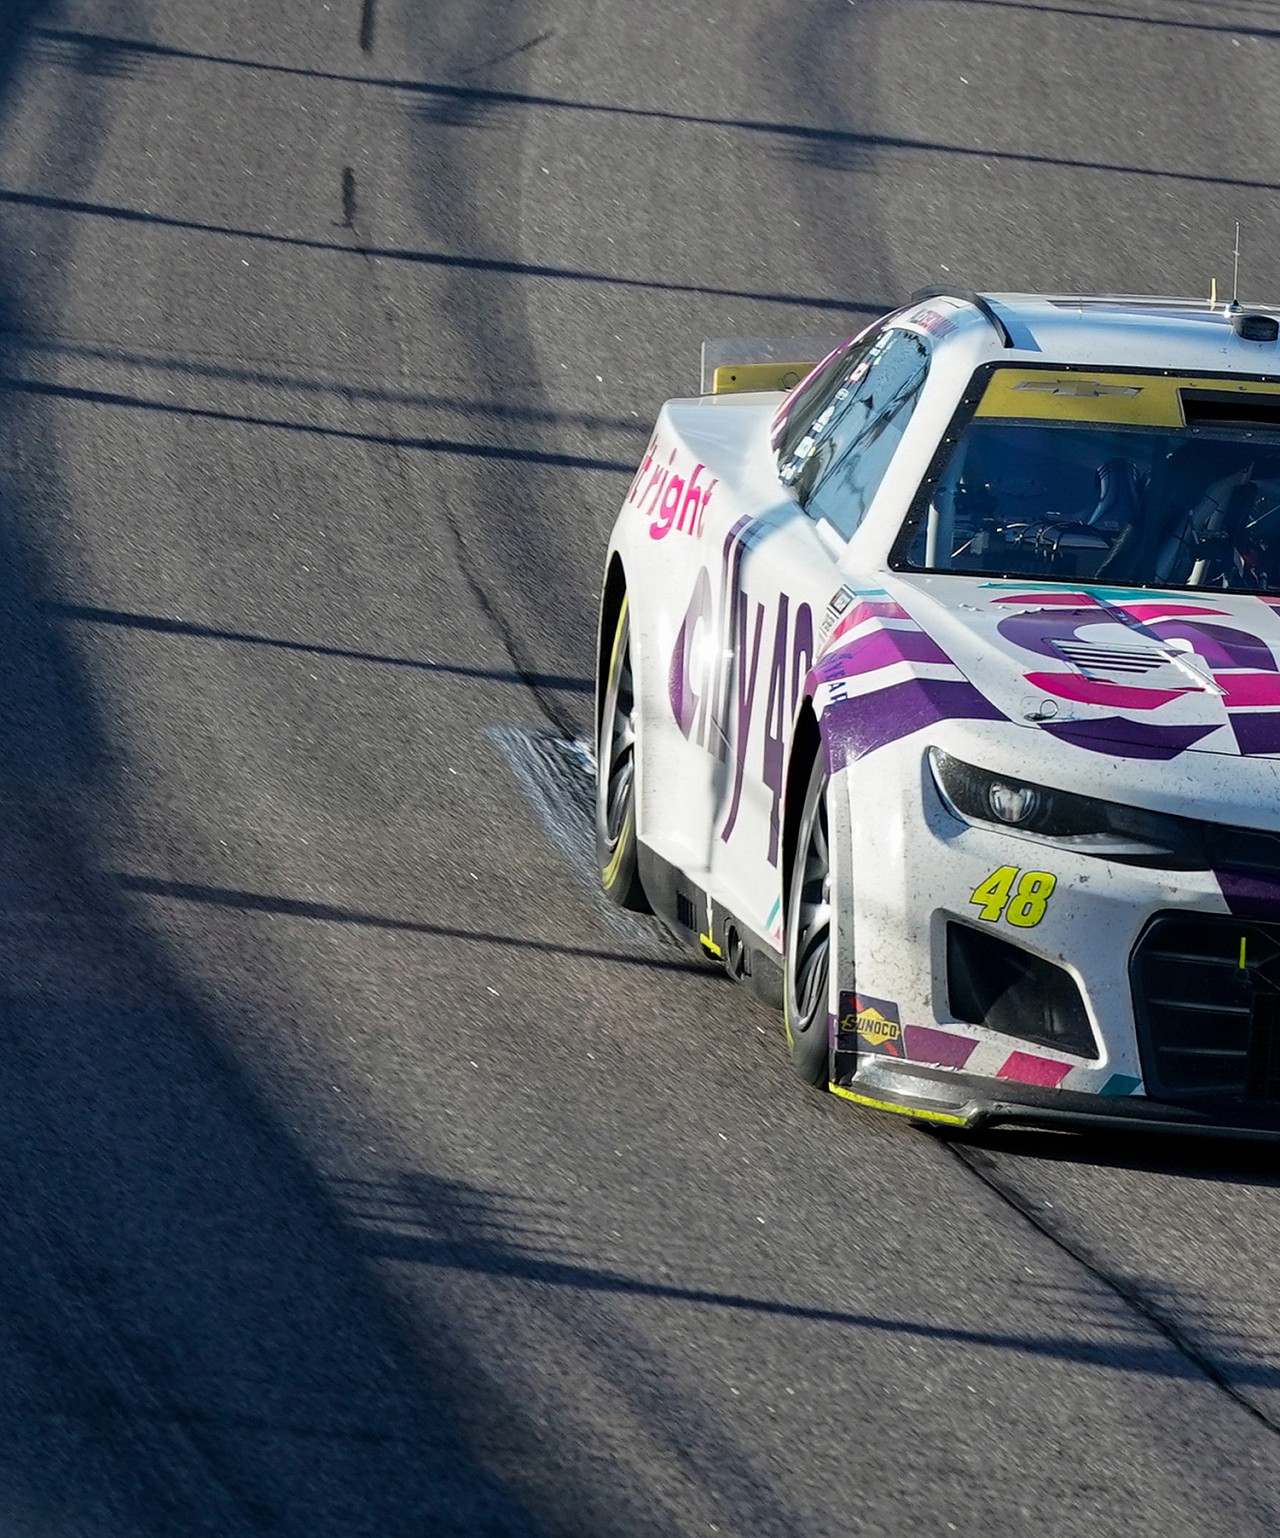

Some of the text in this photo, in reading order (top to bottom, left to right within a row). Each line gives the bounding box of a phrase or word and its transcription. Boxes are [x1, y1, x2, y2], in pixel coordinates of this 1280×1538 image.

[637, 447, 719, 541] right
[969, 865, 1058, 928] 48
[842, 1015, 898, 1039] SUNOCO
